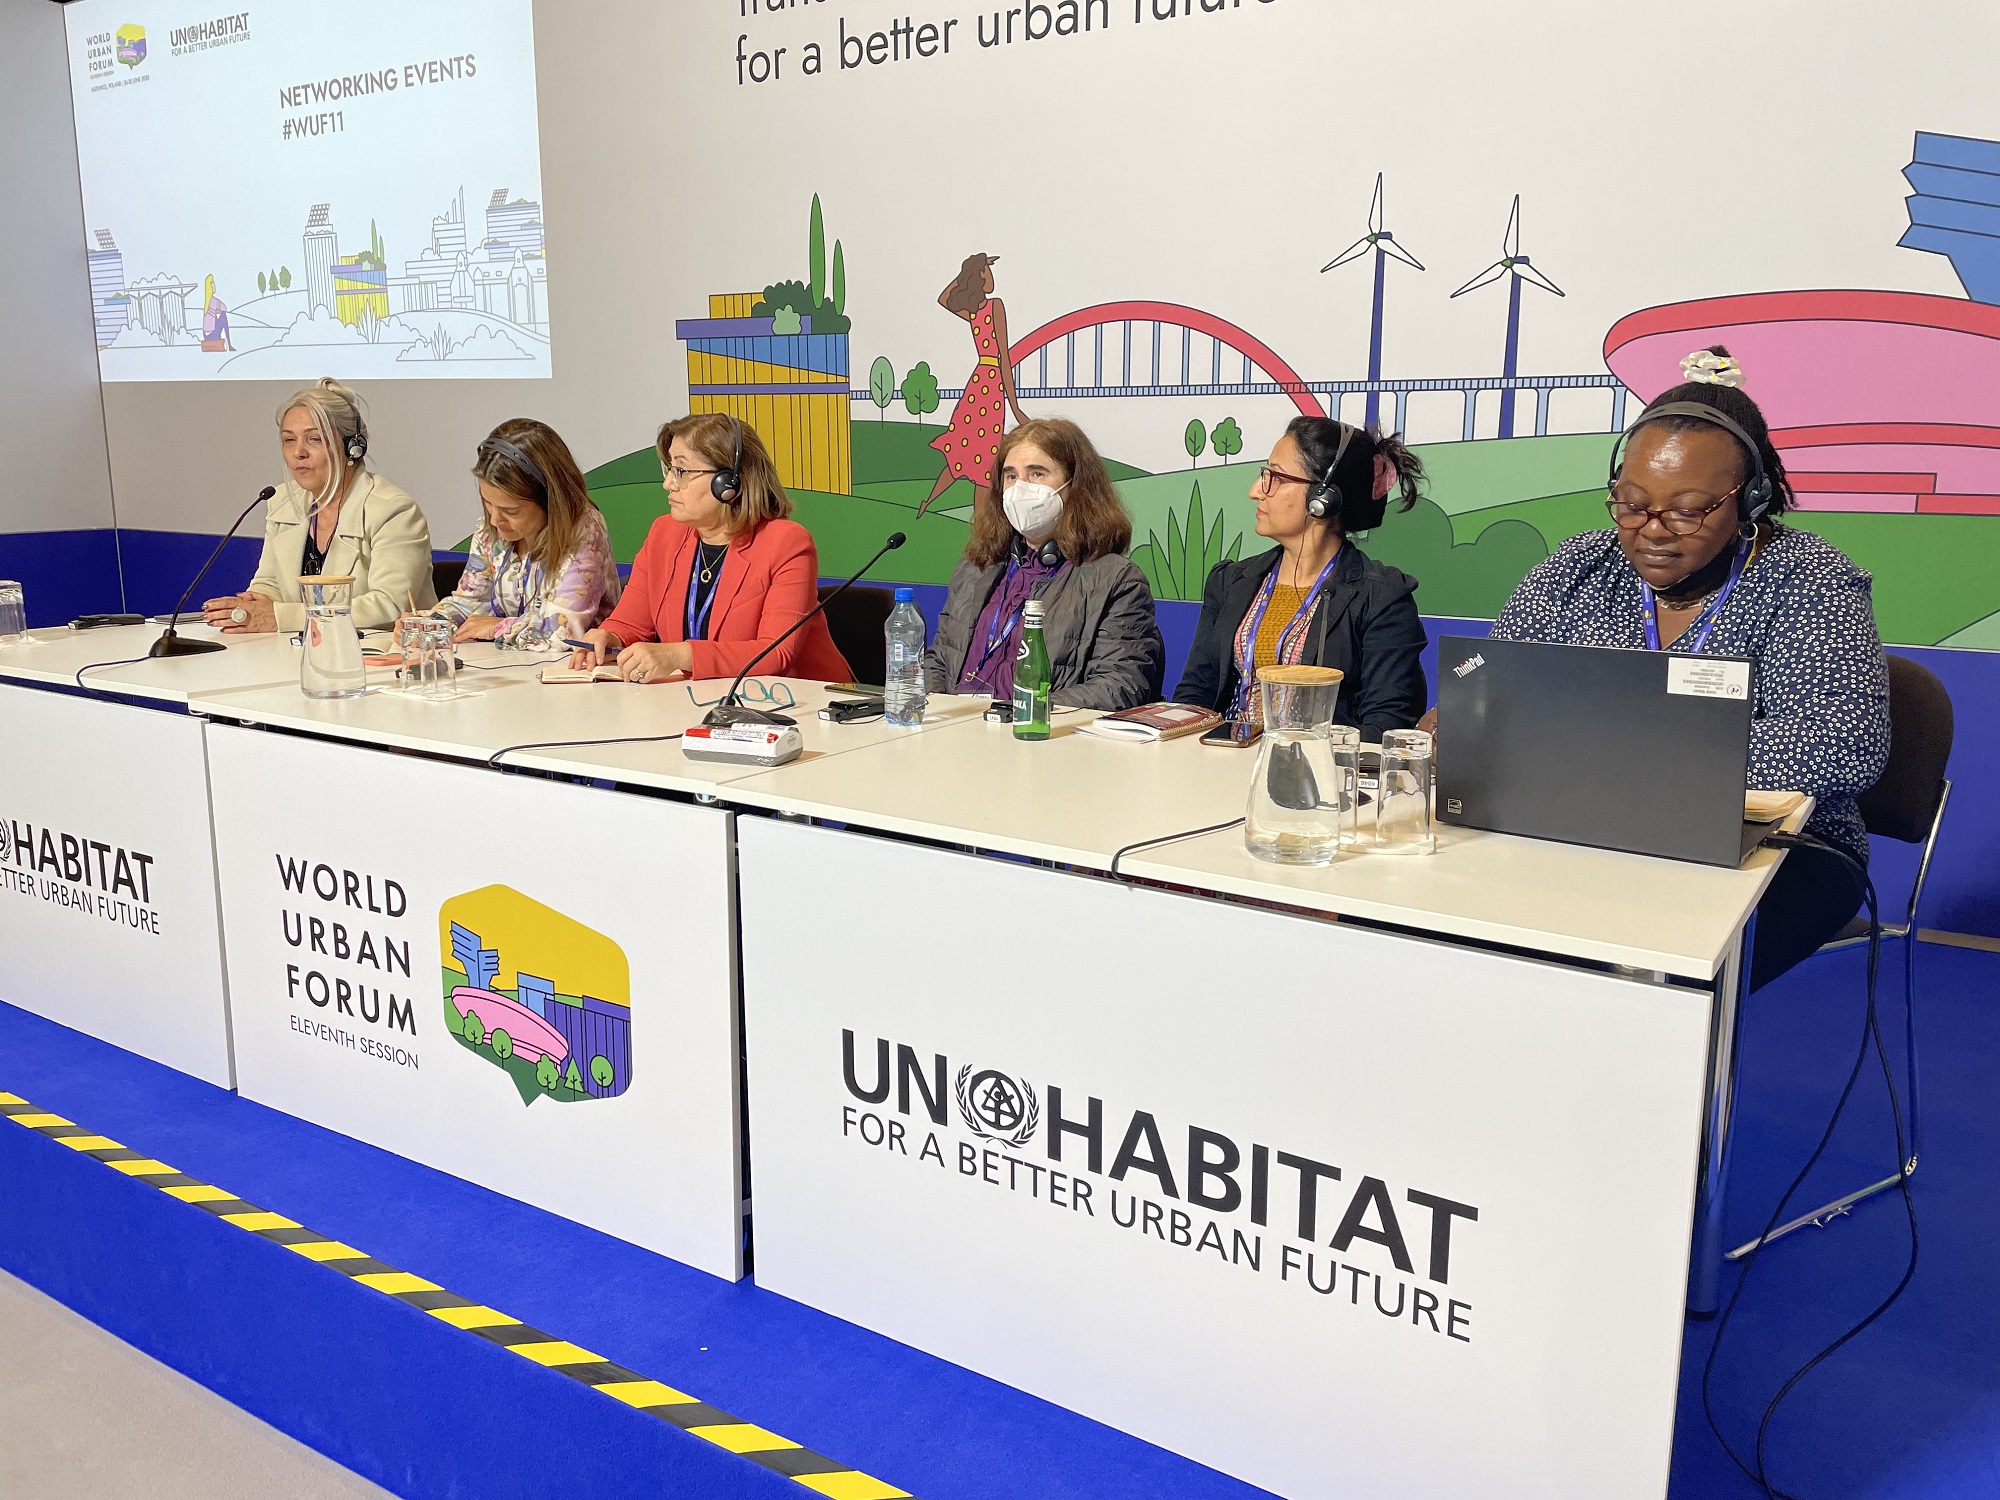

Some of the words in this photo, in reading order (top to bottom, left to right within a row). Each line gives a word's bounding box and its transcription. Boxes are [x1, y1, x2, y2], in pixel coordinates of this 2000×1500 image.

[86, 32, 111, 46] WORLD
[87, 45, 112, 59] URBAN
[170, 27, 187, 47] UN
[199, 12, 249, 41] HABITAT
[171, 47, 182, 57] FOR
[183, 46, 188, 54] A
[188, 41, 208, 53] BETTER
[208, 36, 228, 49] URBAN
[228, 31, 251, 44] FUTURE
[736, 34, 787, 85] for
[801, 42, 822, 76] a
[840, 16, 958, 70] better
[977, 0, 1109, 48] urban
[89, 58, 114, 72] FORUM
[279, 67, 398, 109] NETWORKING
[404, 53, 477, 88] EVENTS
[282, 110, 344, 140] #WUF11
[1453, 652, 1486, 679] ThinkPad
[11, 819, 154, 904] HABITAT
[275, 853, 407, 918] WORLD
[39, 878, 93, 914] URBAN
[97, 895, 160, 935] FUTURE
[282, 909, 412, 979] URBAN
[286, 963, 417, 1037] FORUM
[290, 1014, 356, 1050] ELEVENTH
[360, 1037, 419, 1070] SESSION
[842, 1027, 948, 1127] UN
[1047, 1084, 1479, 1285] HABITAT
[842, 1105, 908, 1156] FOR
[919, 1132, 946, 1168] A
[958, 1141, 1095, 1217] BETTER
[1110, 1189, 1261, 1273] URBAN
[1281, 1244, 1473, 1344] FUTURE
